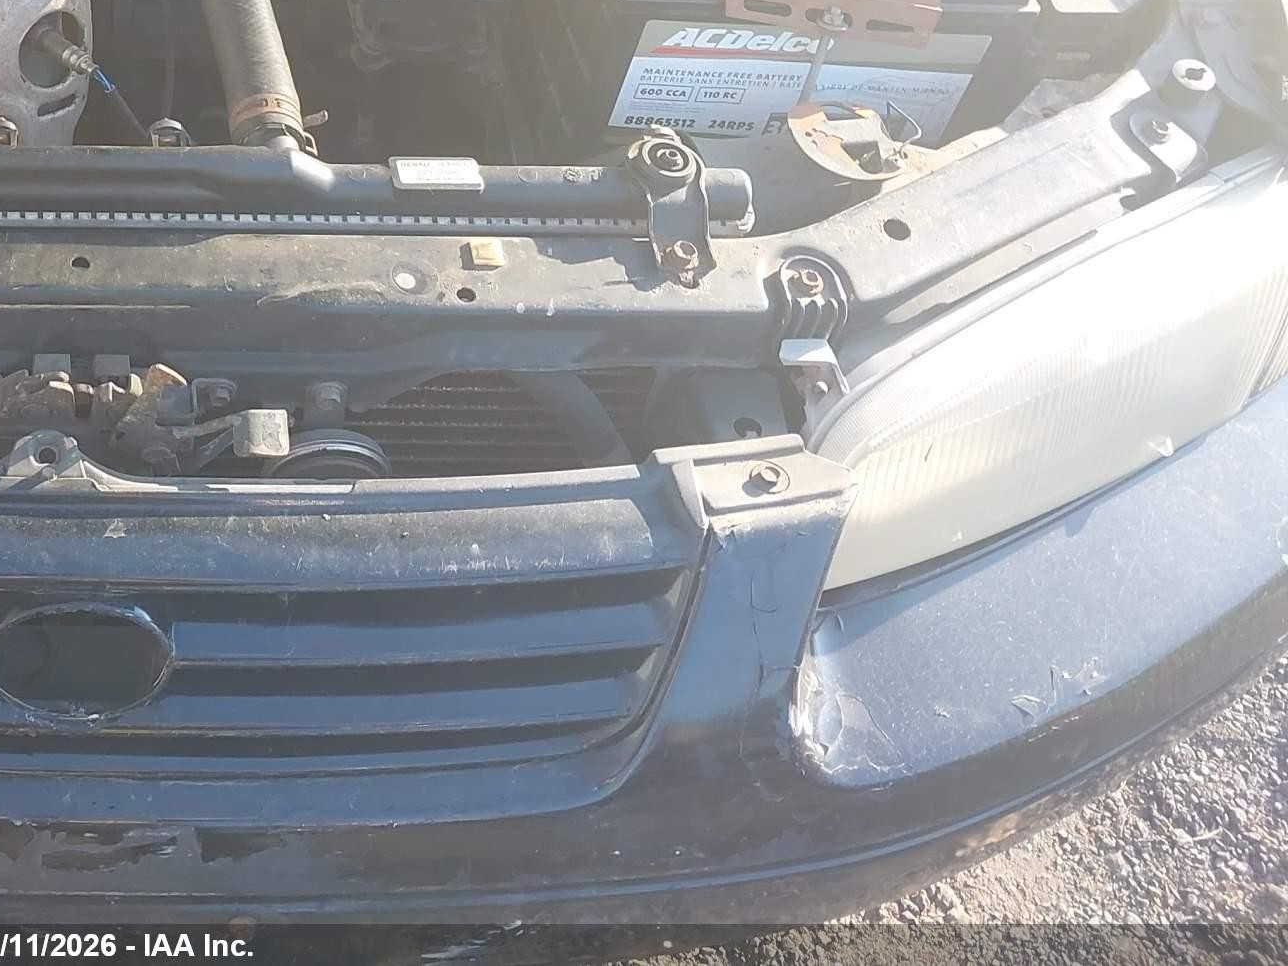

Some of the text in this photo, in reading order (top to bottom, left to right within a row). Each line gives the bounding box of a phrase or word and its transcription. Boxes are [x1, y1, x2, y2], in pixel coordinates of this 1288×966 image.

[640, 75, 686, 84] BATTERIE
[688, 77, 713, 85] SANS
[716, 79, 769, 88] ENTRETIEN
[643, 68, 803, 82] MAINTENANCE FREE BATTERY
[640, 87, 688, 98] 600 CCA
[703, 91, 737, 100] 110 RC
[624, 115, 696, 129] 88865512
[708, 120, 756, 131] 24RPS
